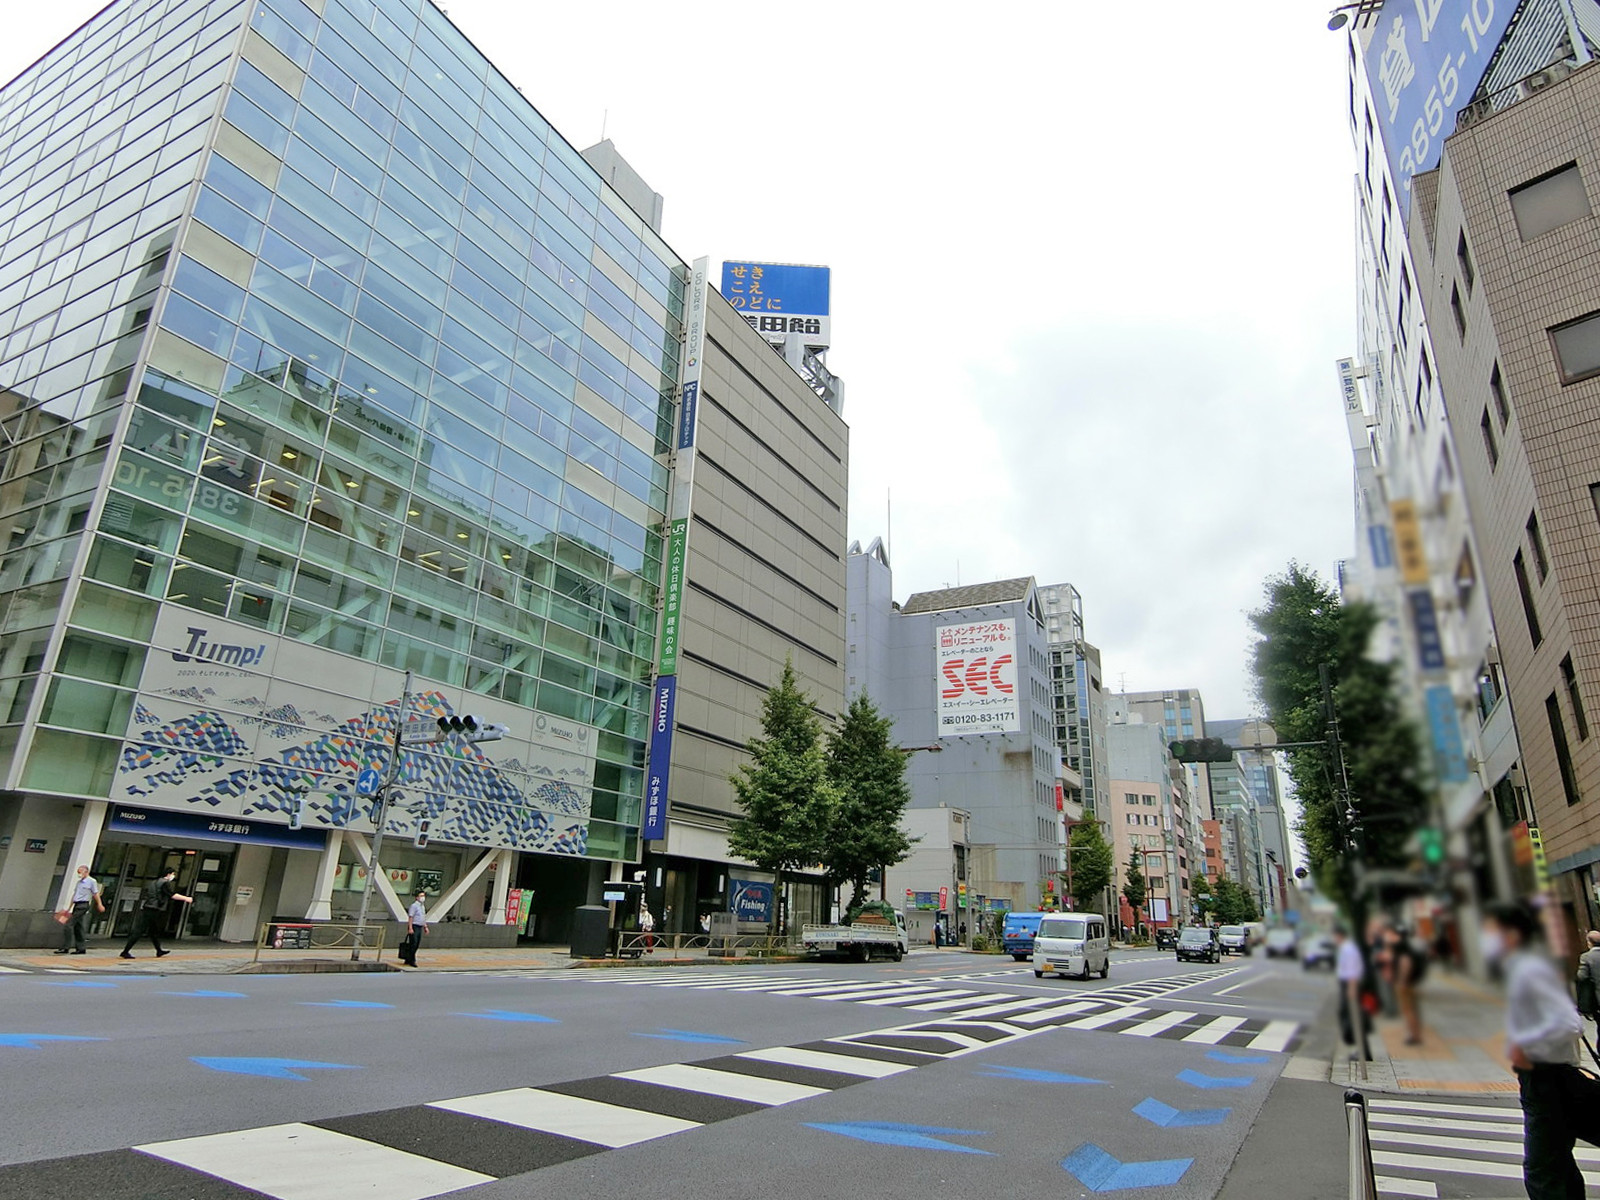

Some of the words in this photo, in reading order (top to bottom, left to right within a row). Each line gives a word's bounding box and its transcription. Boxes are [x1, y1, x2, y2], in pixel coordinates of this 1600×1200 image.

[731, 266, 764, 279] せき
[731, 281, 764, 294] こえ
[730, 296, 782, 310] のどに
[672, 523, 685, 533] JR
[172, 627, 266, 667] Jump!
[658, 688, 669, 733] MIZUHO
[955, 712, 1015, 724] 0120-83-1171
[551, 727, 573, 739] MIZUHO
[648, 776, 660, 827] みずほ銀行
[120, 811, 146, 821] MIZUHO
[208, 822, 250, 835] みずほ銀行
[741, 899, 766, 912] Fishing
